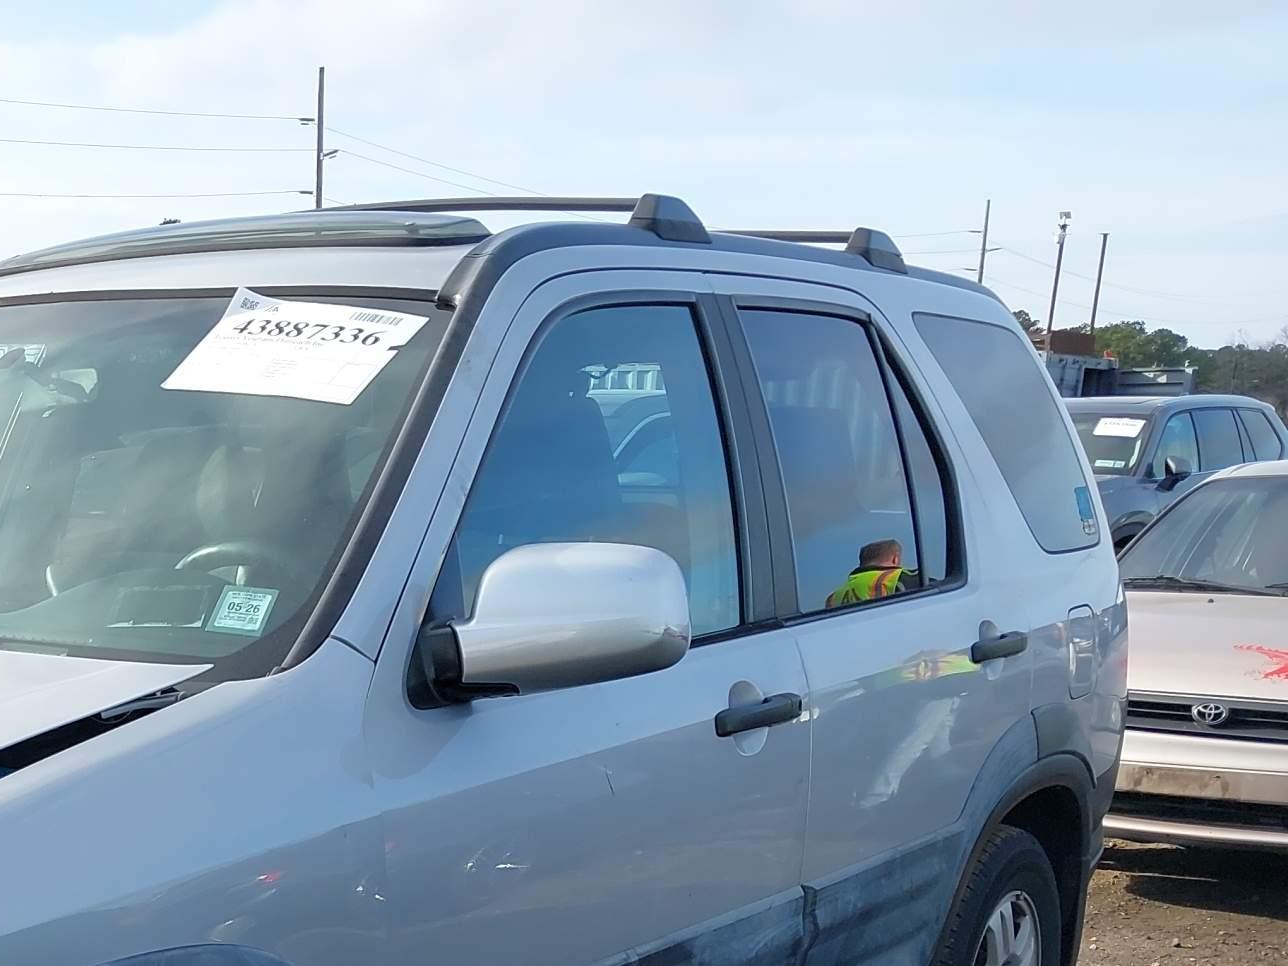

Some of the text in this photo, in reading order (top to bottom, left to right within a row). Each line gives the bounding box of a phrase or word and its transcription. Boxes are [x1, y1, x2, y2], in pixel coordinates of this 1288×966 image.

[232, 317, 388, 347] 43887336
[227, 601, 261, 614] 05 26
